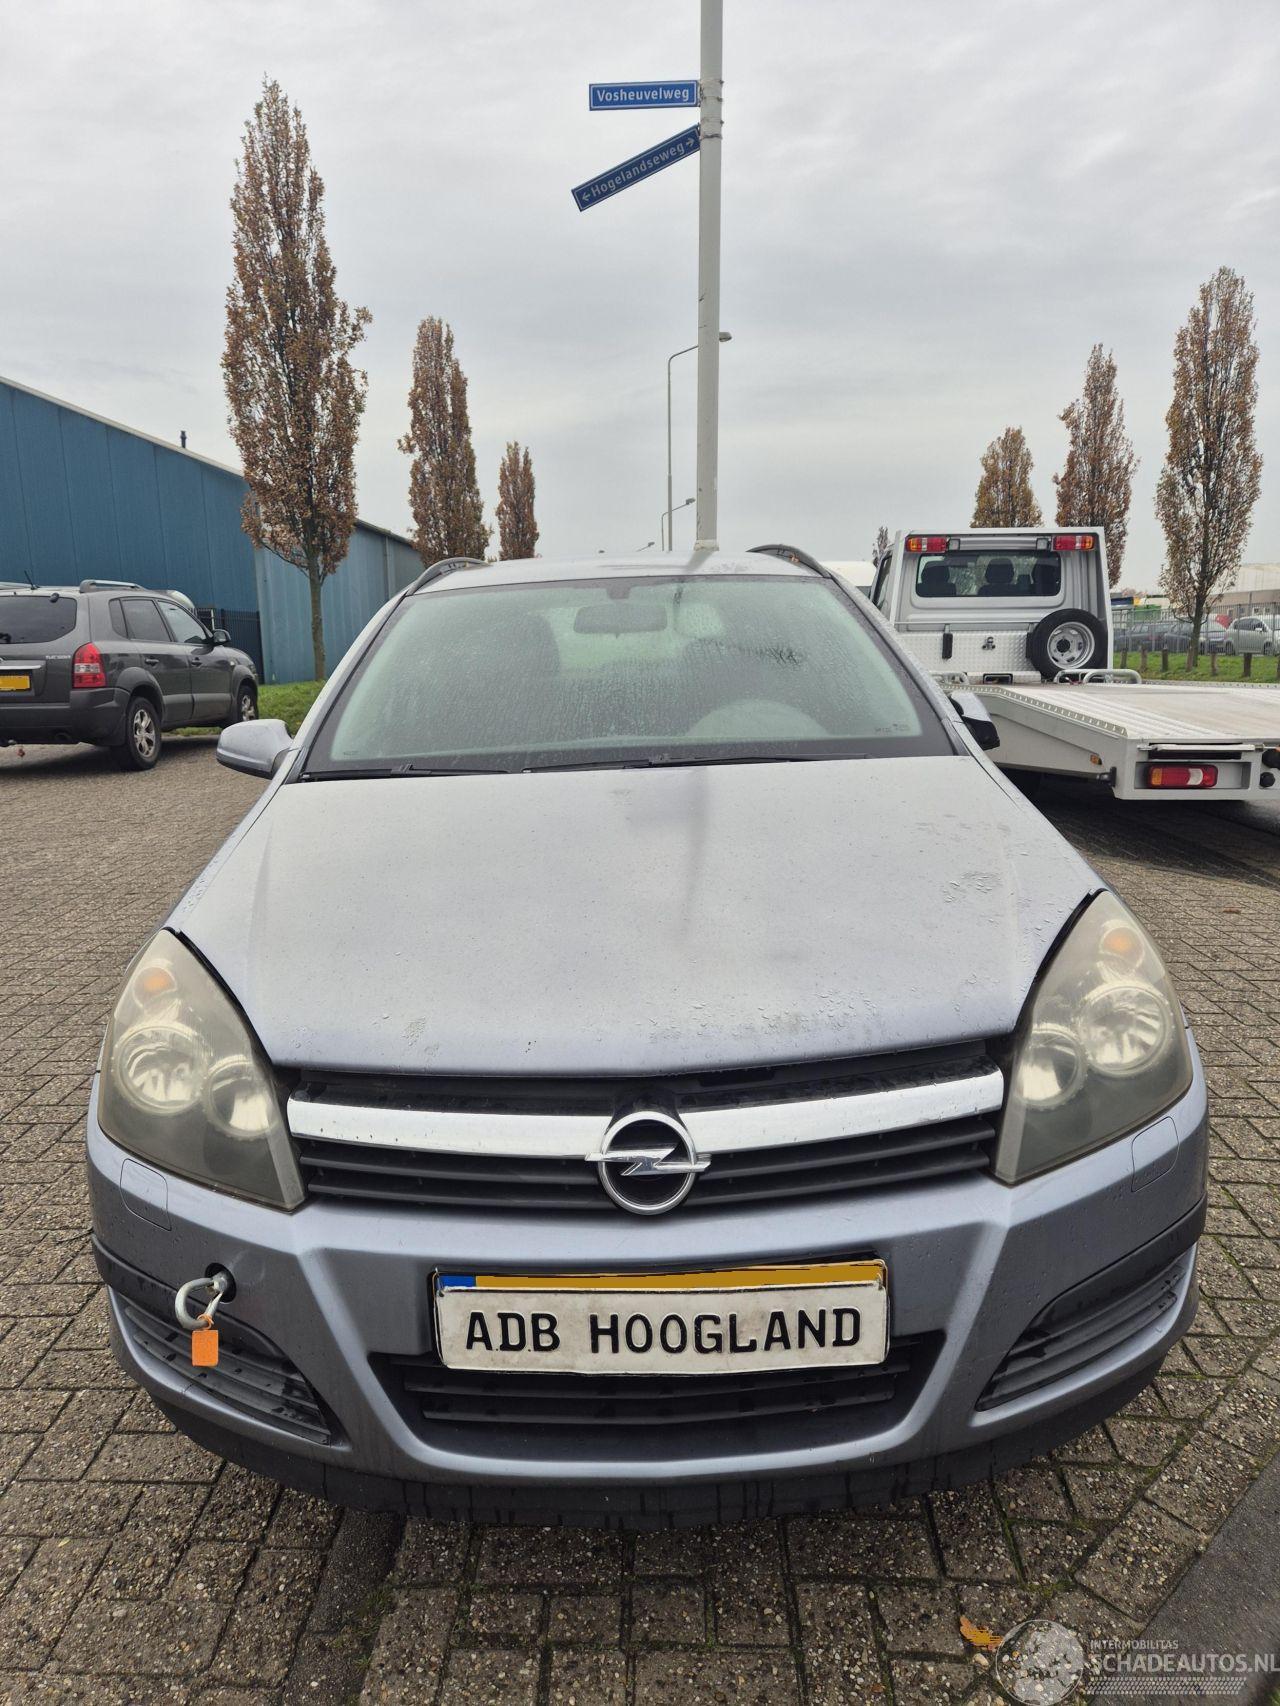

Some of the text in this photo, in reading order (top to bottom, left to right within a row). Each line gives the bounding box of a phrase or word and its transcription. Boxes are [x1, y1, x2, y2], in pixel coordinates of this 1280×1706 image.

[597, 88, 690, 102] Vosheuvelweg
[590, 142, 685, 198] Hogelandseweg
[589, 1306, 862, 1354] HOOGLAND
